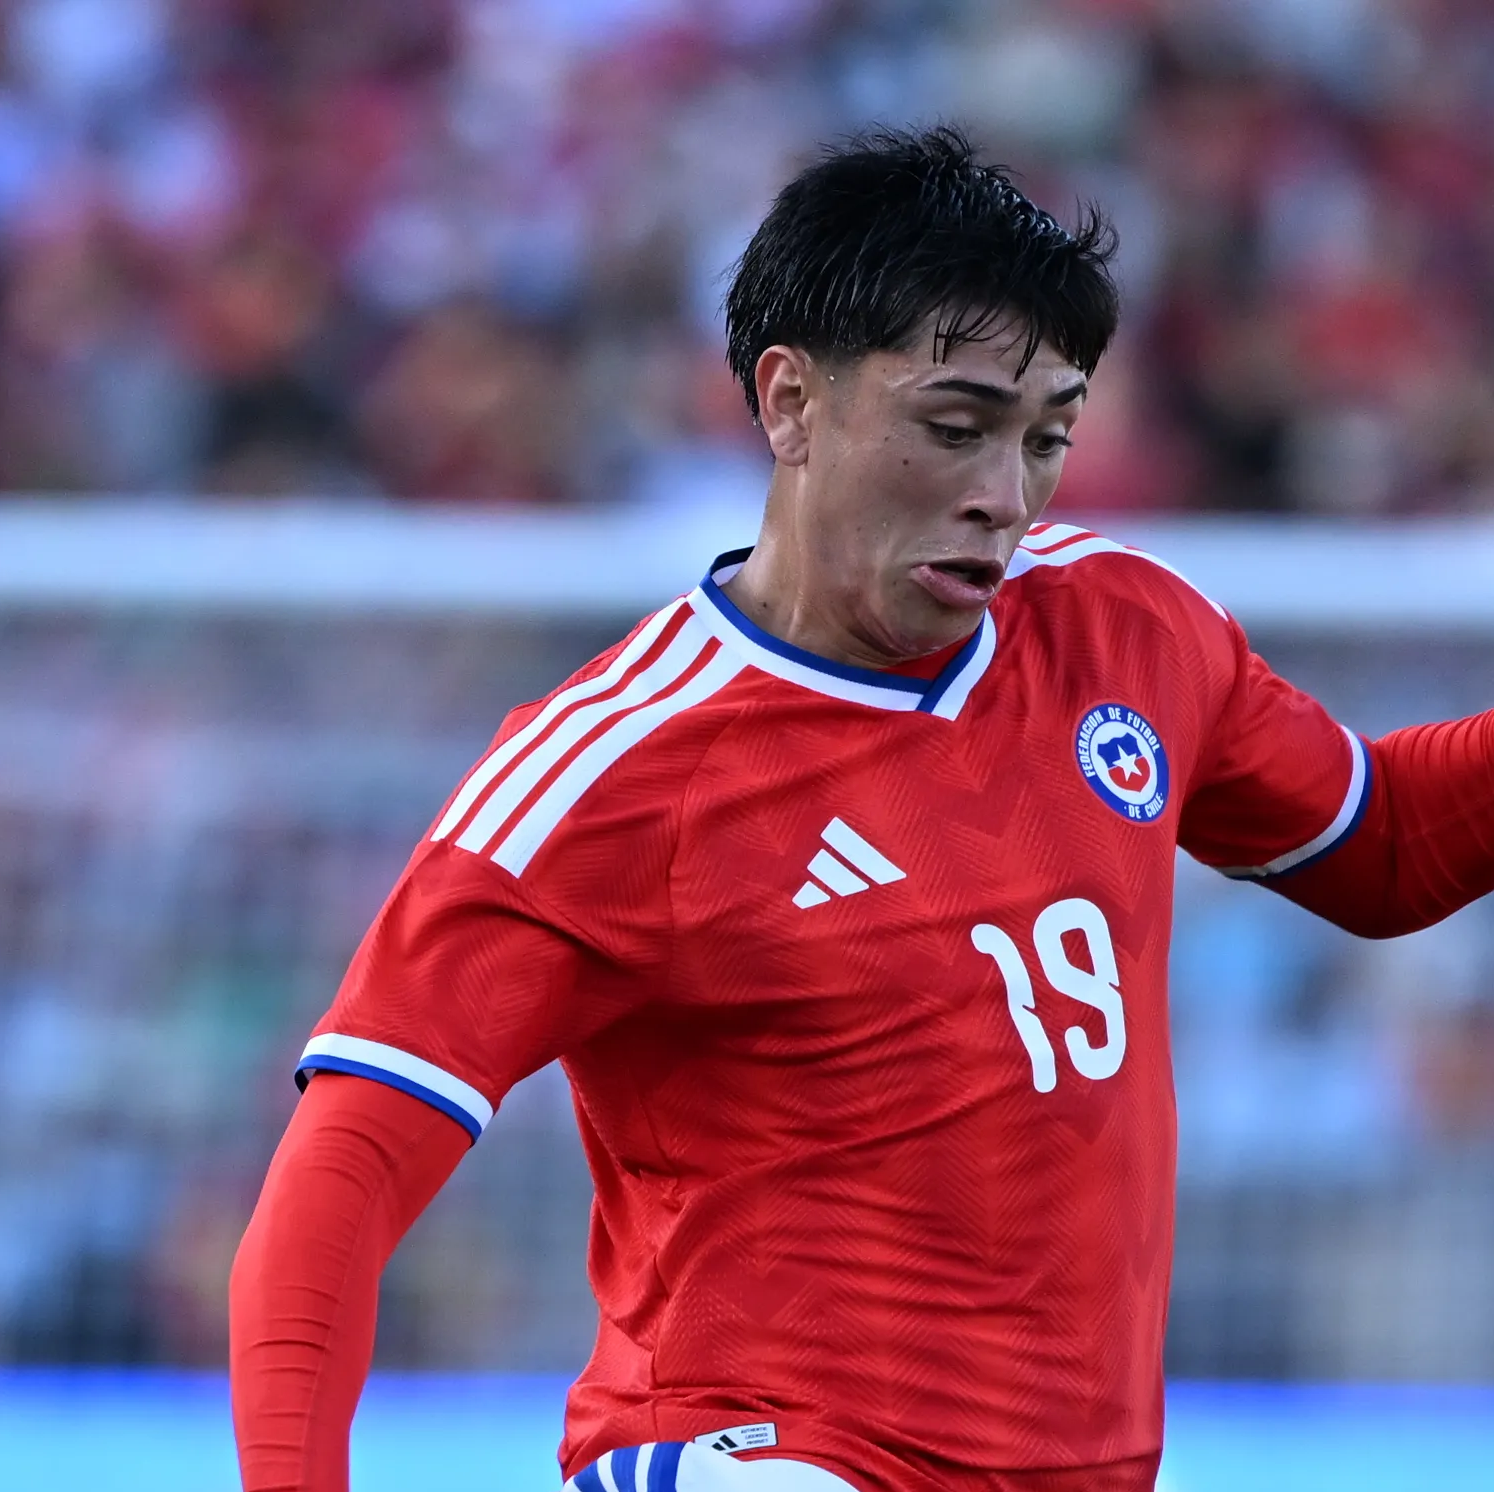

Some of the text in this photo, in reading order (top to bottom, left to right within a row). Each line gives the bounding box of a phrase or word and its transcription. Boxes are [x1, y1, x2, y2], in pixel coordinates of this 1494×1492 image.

[1077, 706, 1161, 778] FEDERACION DE FUTBOL
[1128, 791, 1164, 820] DE CHILE
[971, 897, 1127, 1093] 19
